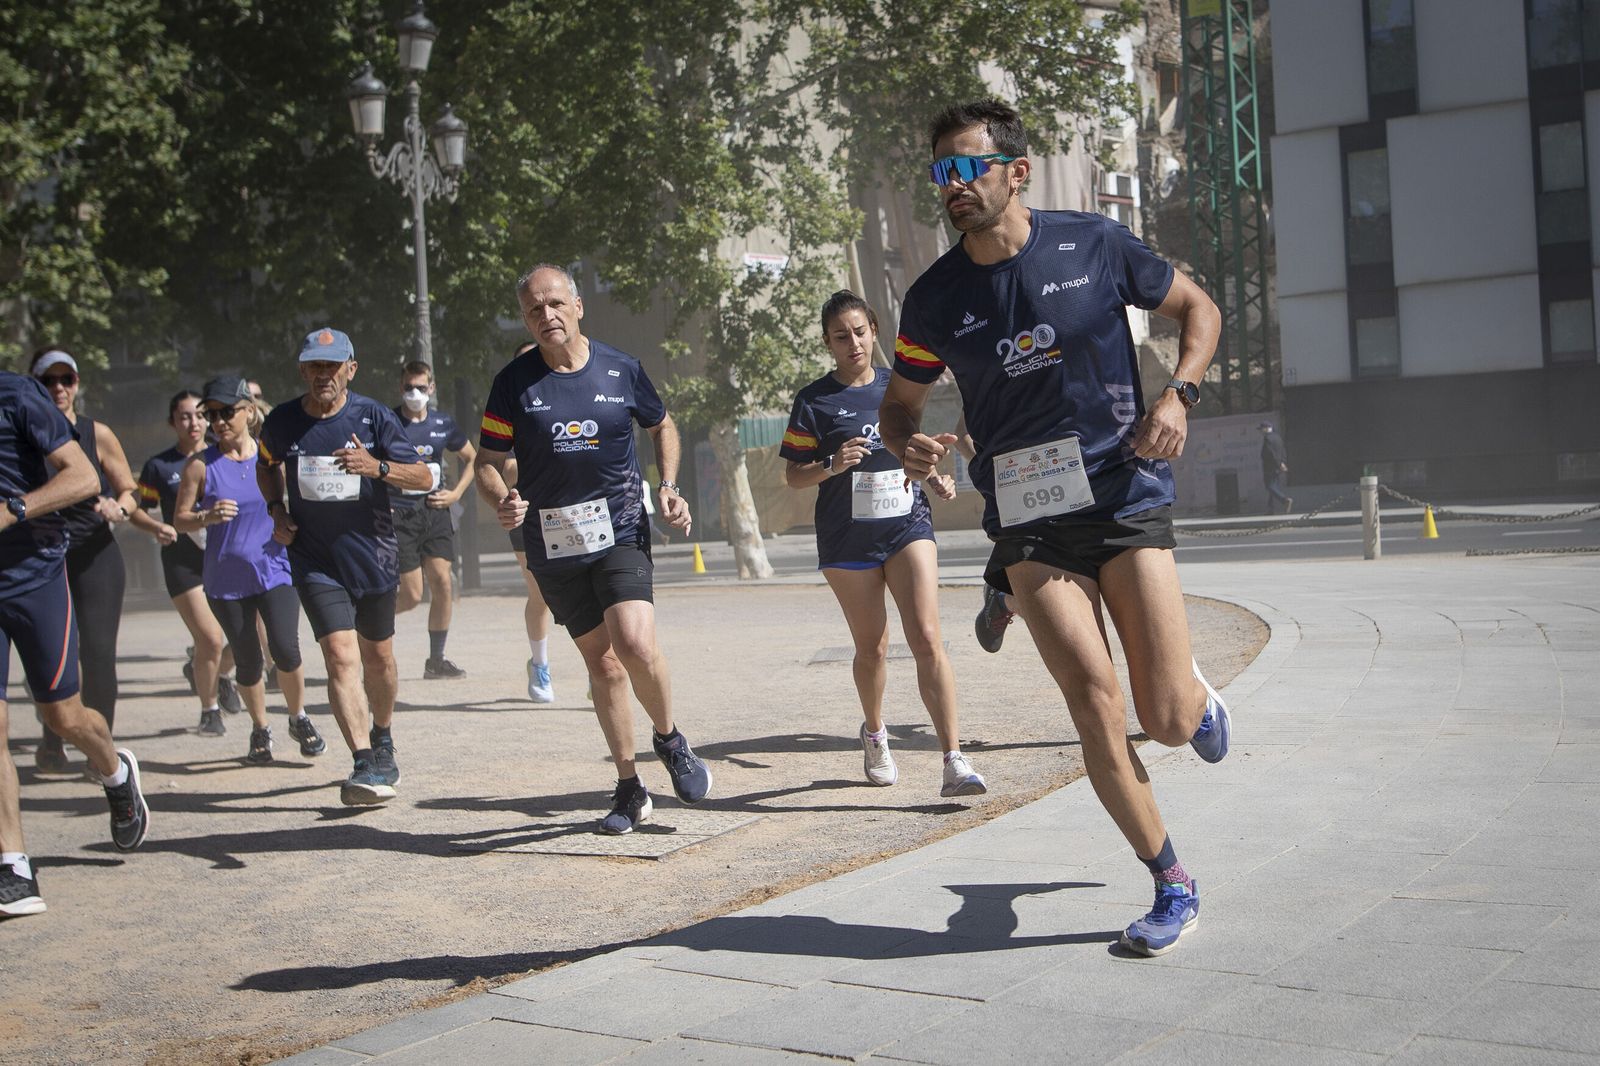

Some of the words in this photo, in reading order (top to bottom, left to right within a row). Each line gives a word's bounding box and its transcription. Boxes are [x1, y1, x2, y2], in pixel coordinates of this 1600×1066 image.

[1061, 275, 1090, 290] mupol
[954, 318, 989, 338] Santander
[996, 323, 1056, 365] 200
[1004, 352, 1049, 373] POLICIA
[1008, 358, 1063, 378] NACIONAL
[524, 405, 552, 413] Santander
[551, 419, 599, 440] 200
[553, 445, 599, 453] NACIONAL
[316, 482, 344, 493] 429
[873, 497, 899, 511] 700
[1023, 485, 1065, 509] 699
[565, 531, 596, 547] 392
